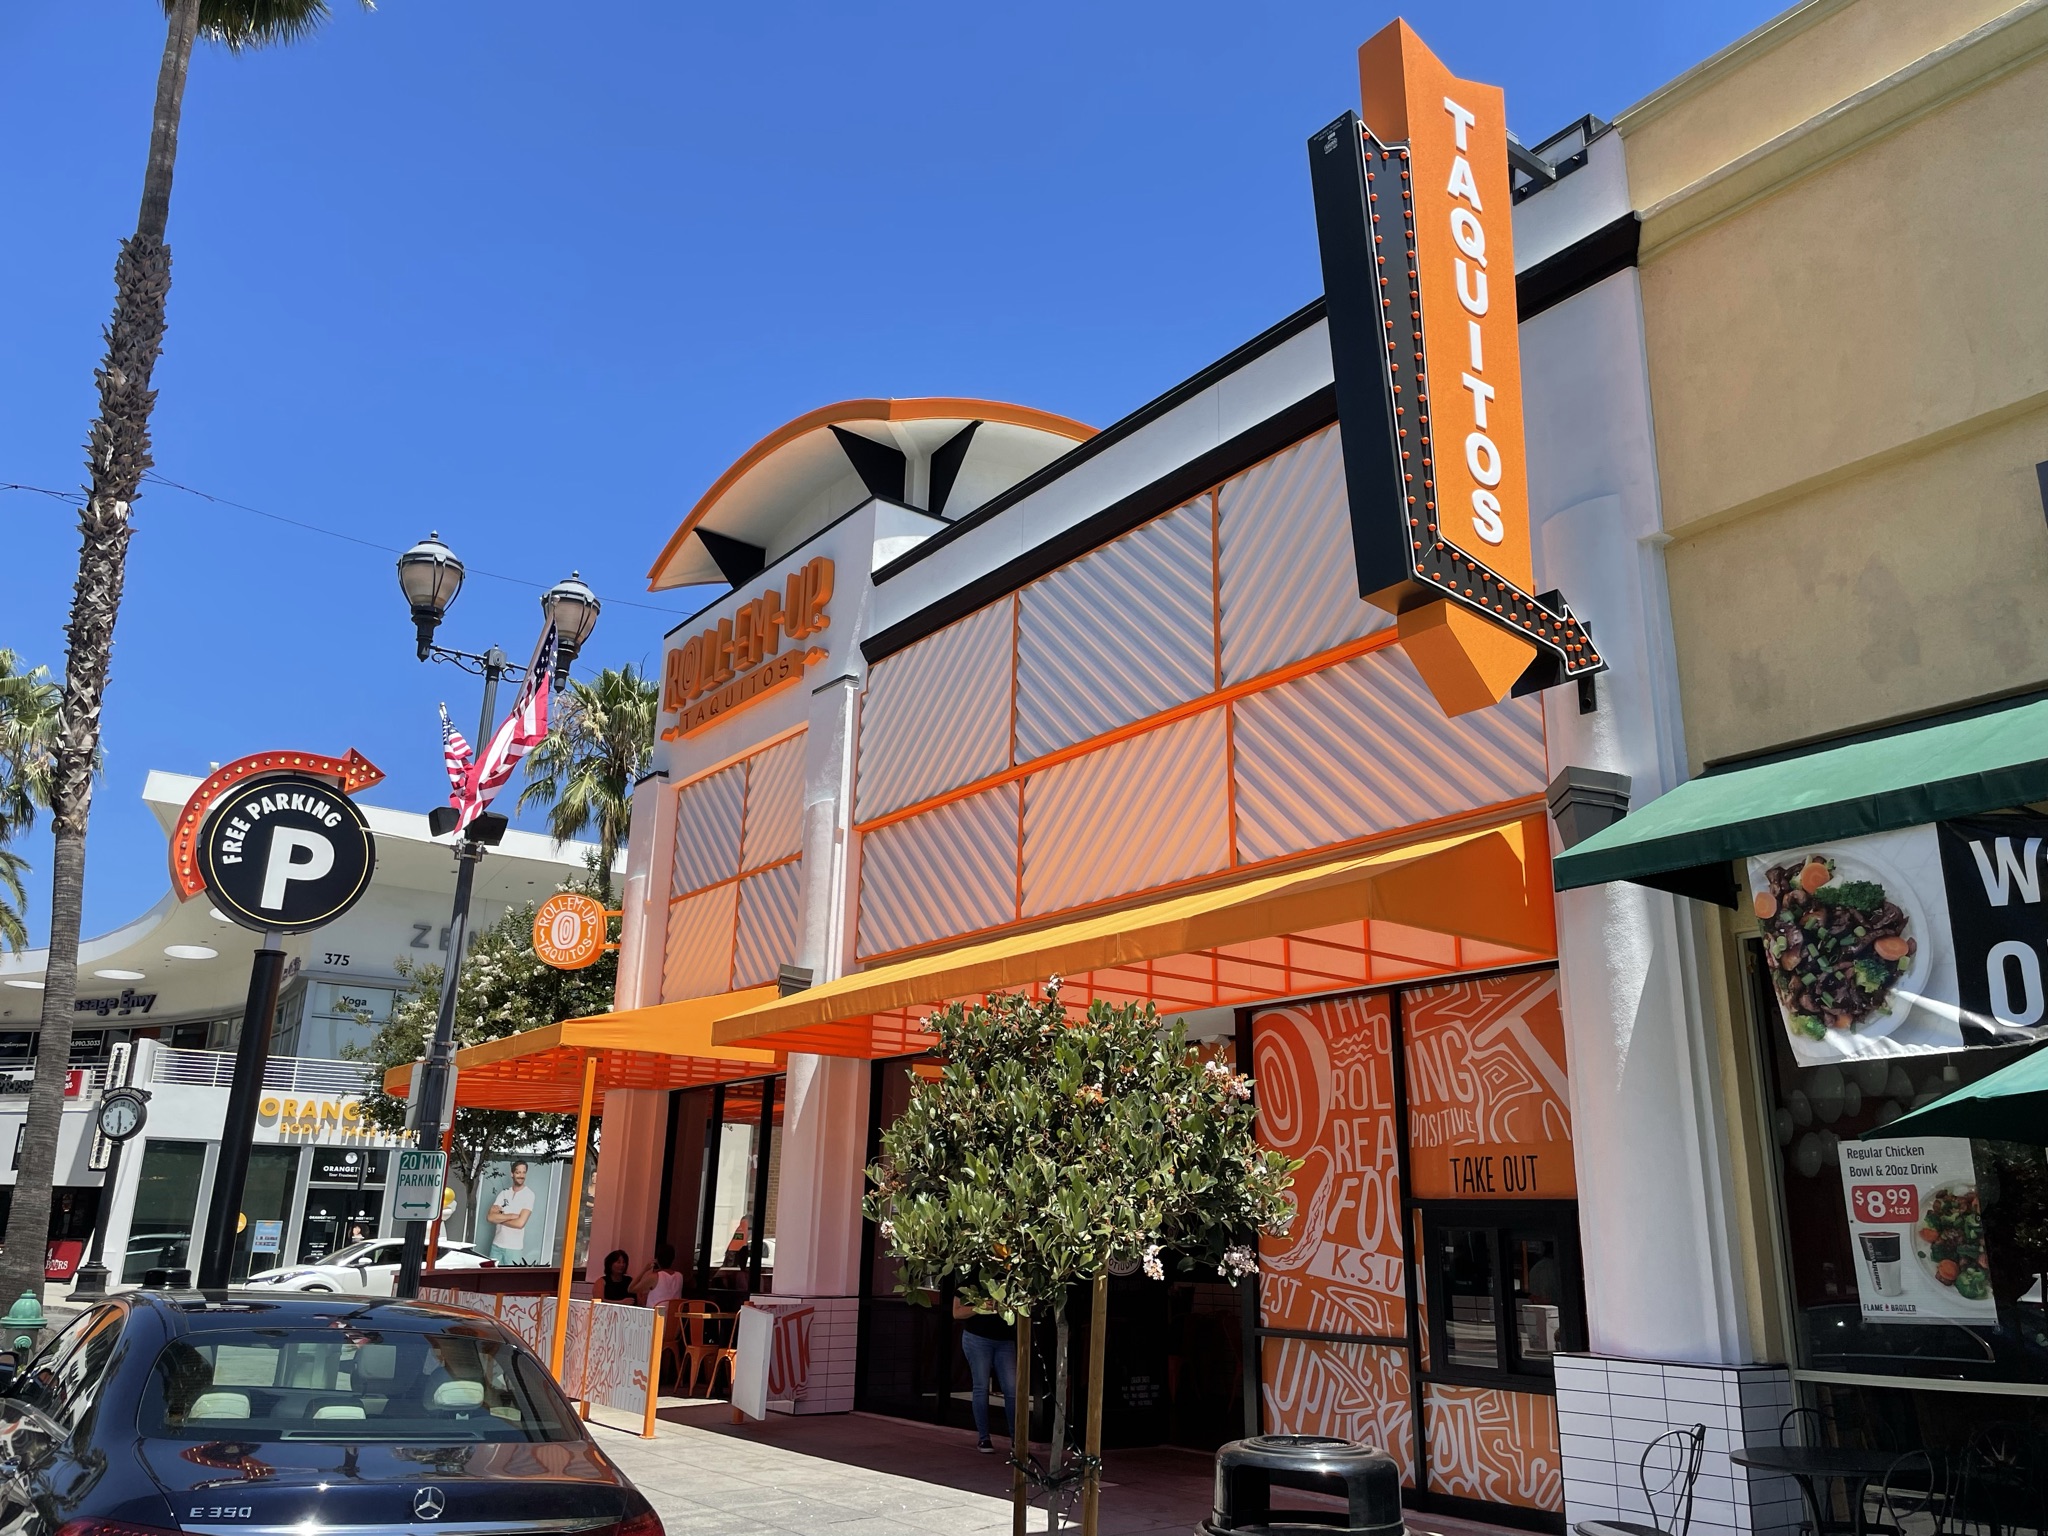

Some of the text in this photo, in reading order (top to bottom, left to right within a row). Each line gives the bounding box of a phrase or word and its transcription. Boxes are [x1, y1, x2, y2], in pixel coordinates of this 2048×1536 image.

[1443, 95, 1505, 546] TAQUITOS
[683, 657, 789, 730] TAQUITOS
[222, 793, 342, 865] FREE PARKING
[260, 826, 335, 911] P
[538, 897, 597, 927] ROLL-EM-UP
[538, 938, 593, 961] TAQUITOS
[324, 953, 350, 966] 375
[74, 988, 157, 1016] ssage Envy
[342, 995, 367, 1007] Yoga
[259, 1097, 371, 1121] ORANG
[281, 1123, 378, 1138] BODY FACE
[1847, 1145, 1924, 1161] Regular Chicken
[323, 1165, 376, 1174] ORANGETST
[402, 1154, 443, 1169] 20 MIN
[1449, 1155, 1538, 1193] TAKE OUT
[1850, 1163, 1938, 1178] Bowl & 20oz Drink
[400, 1174, 441, 1187] PARKING
[1863, 1304, 1917, 1312] FLAME BROILER
[189, 1506, 252, 1518] E 350
